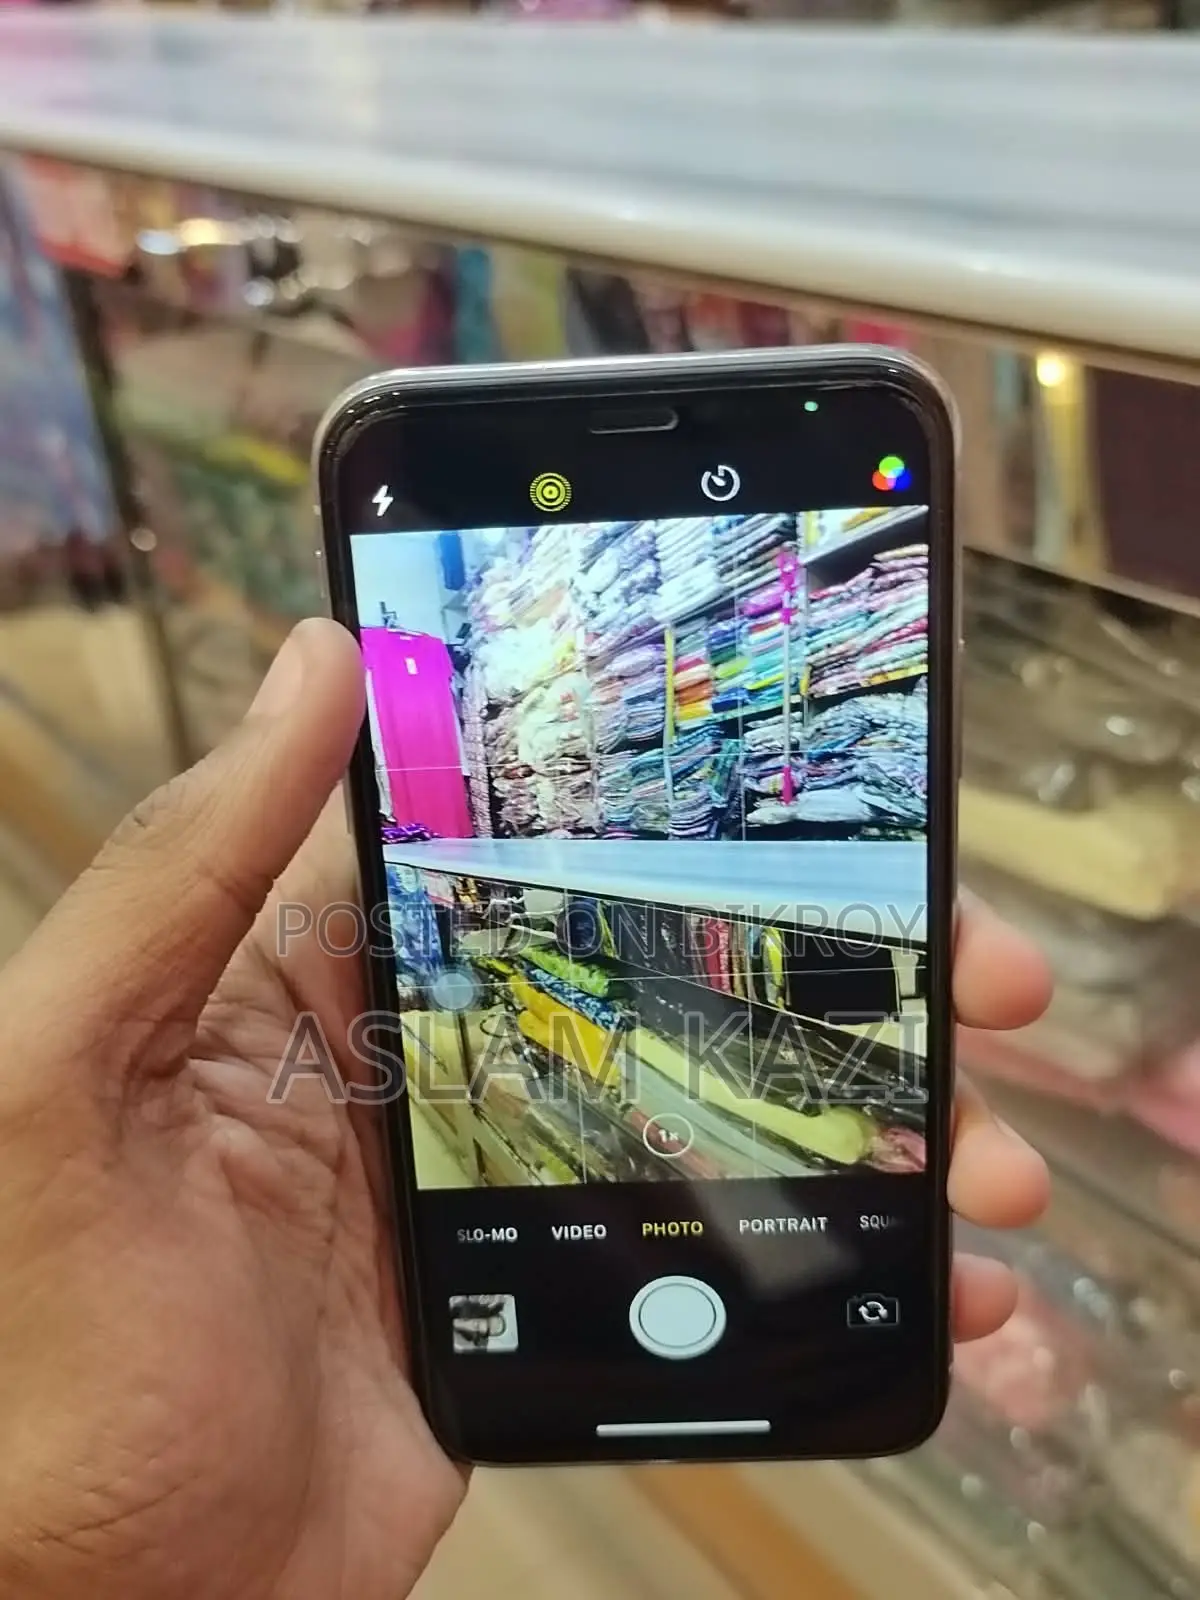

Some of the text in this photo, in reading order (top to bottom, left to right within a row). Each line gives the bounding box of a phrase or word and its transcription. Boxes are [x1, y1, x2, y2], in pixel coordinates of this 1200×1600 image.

[457, 1226, 519, 1243] SLO-MO
[551, 1223, 608, 1241] VIDEO
[642, 1220, 704, 1238] PHOTO
[738, 1215, 829, 1235] PORTRAIT
